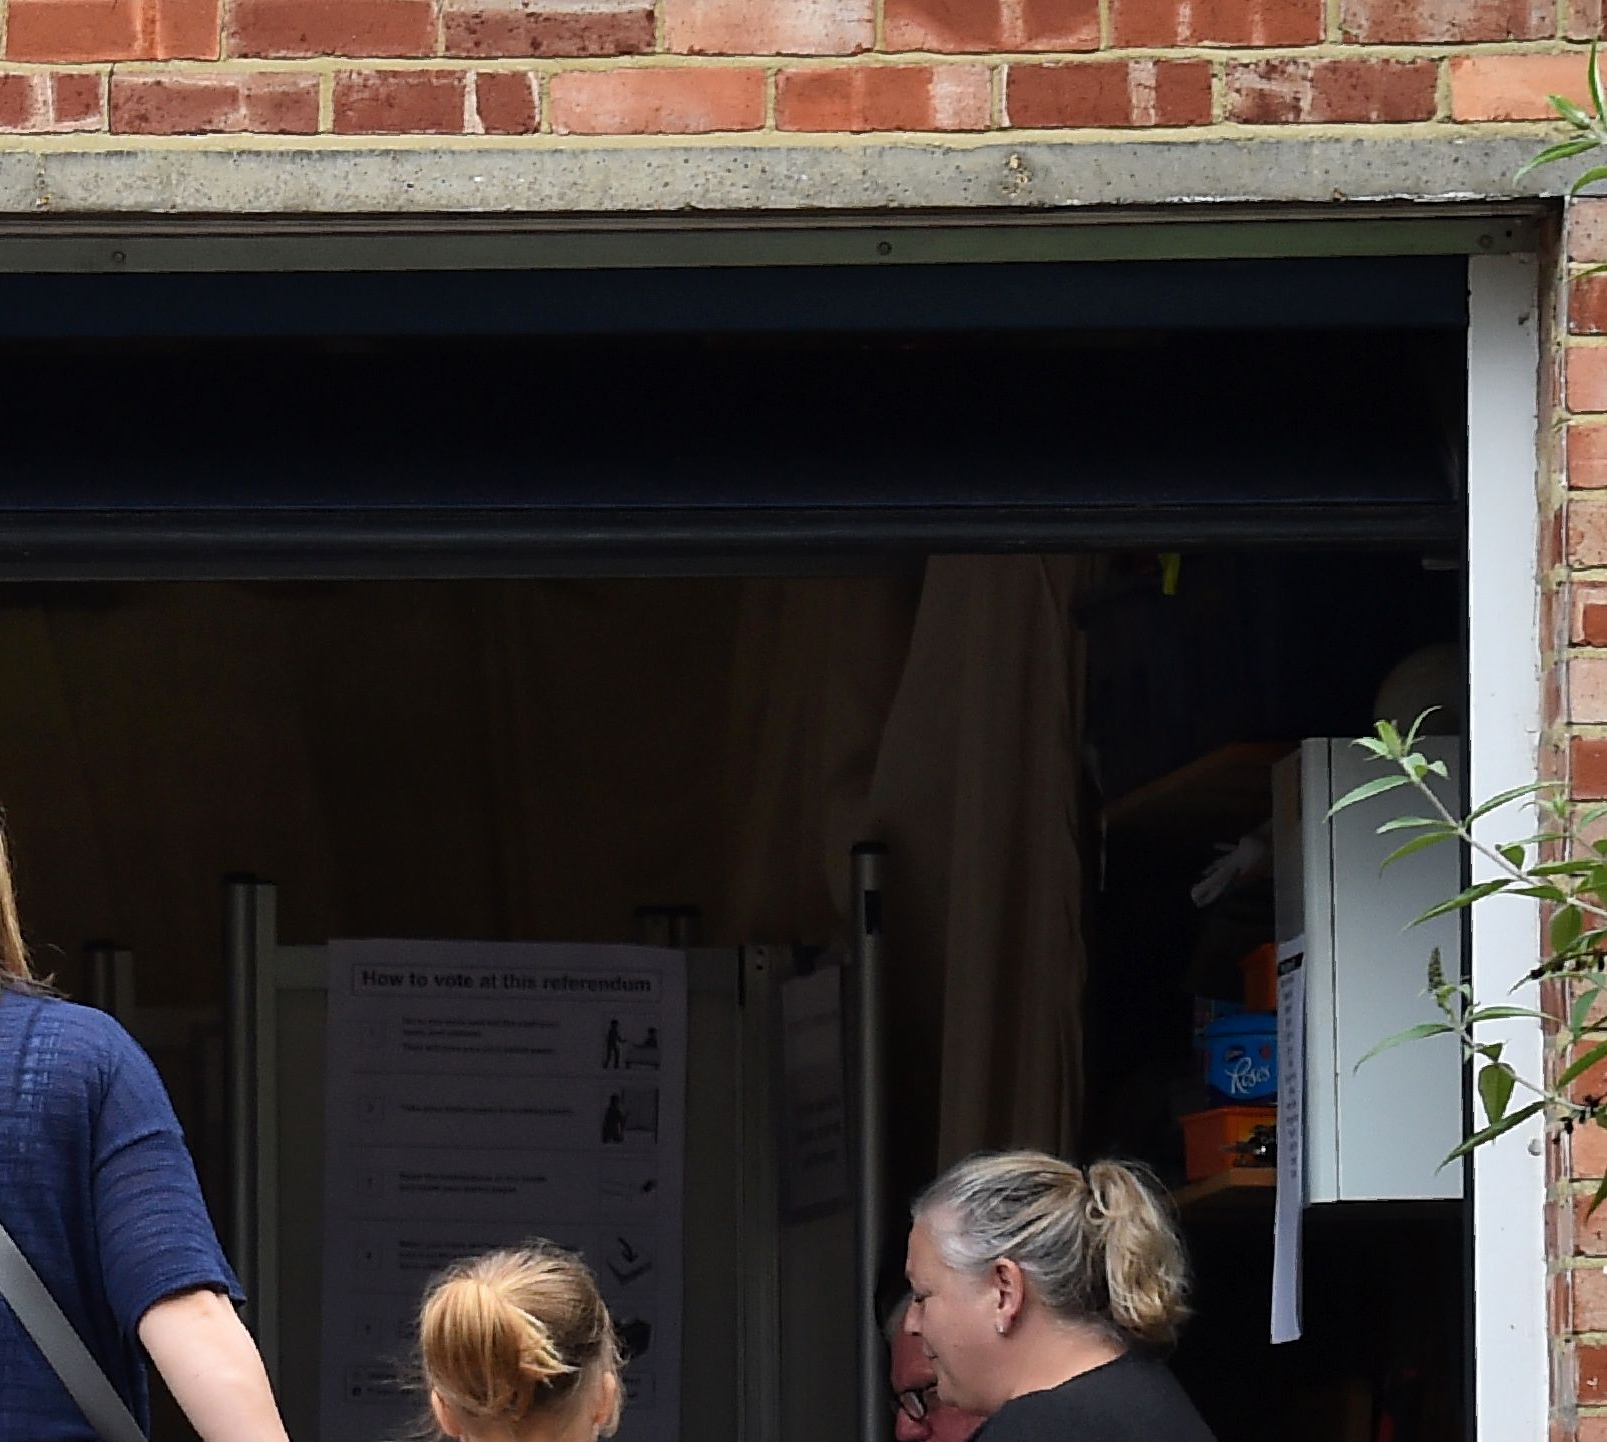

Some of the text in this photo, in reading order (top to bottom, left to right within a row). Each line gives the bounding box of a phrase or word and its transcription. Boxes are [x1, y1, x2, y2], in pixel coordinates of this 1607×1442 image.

[362, 971, 651, 992] How to vote at this referendum
[1224, 1057, 1270, 1094] Roses
